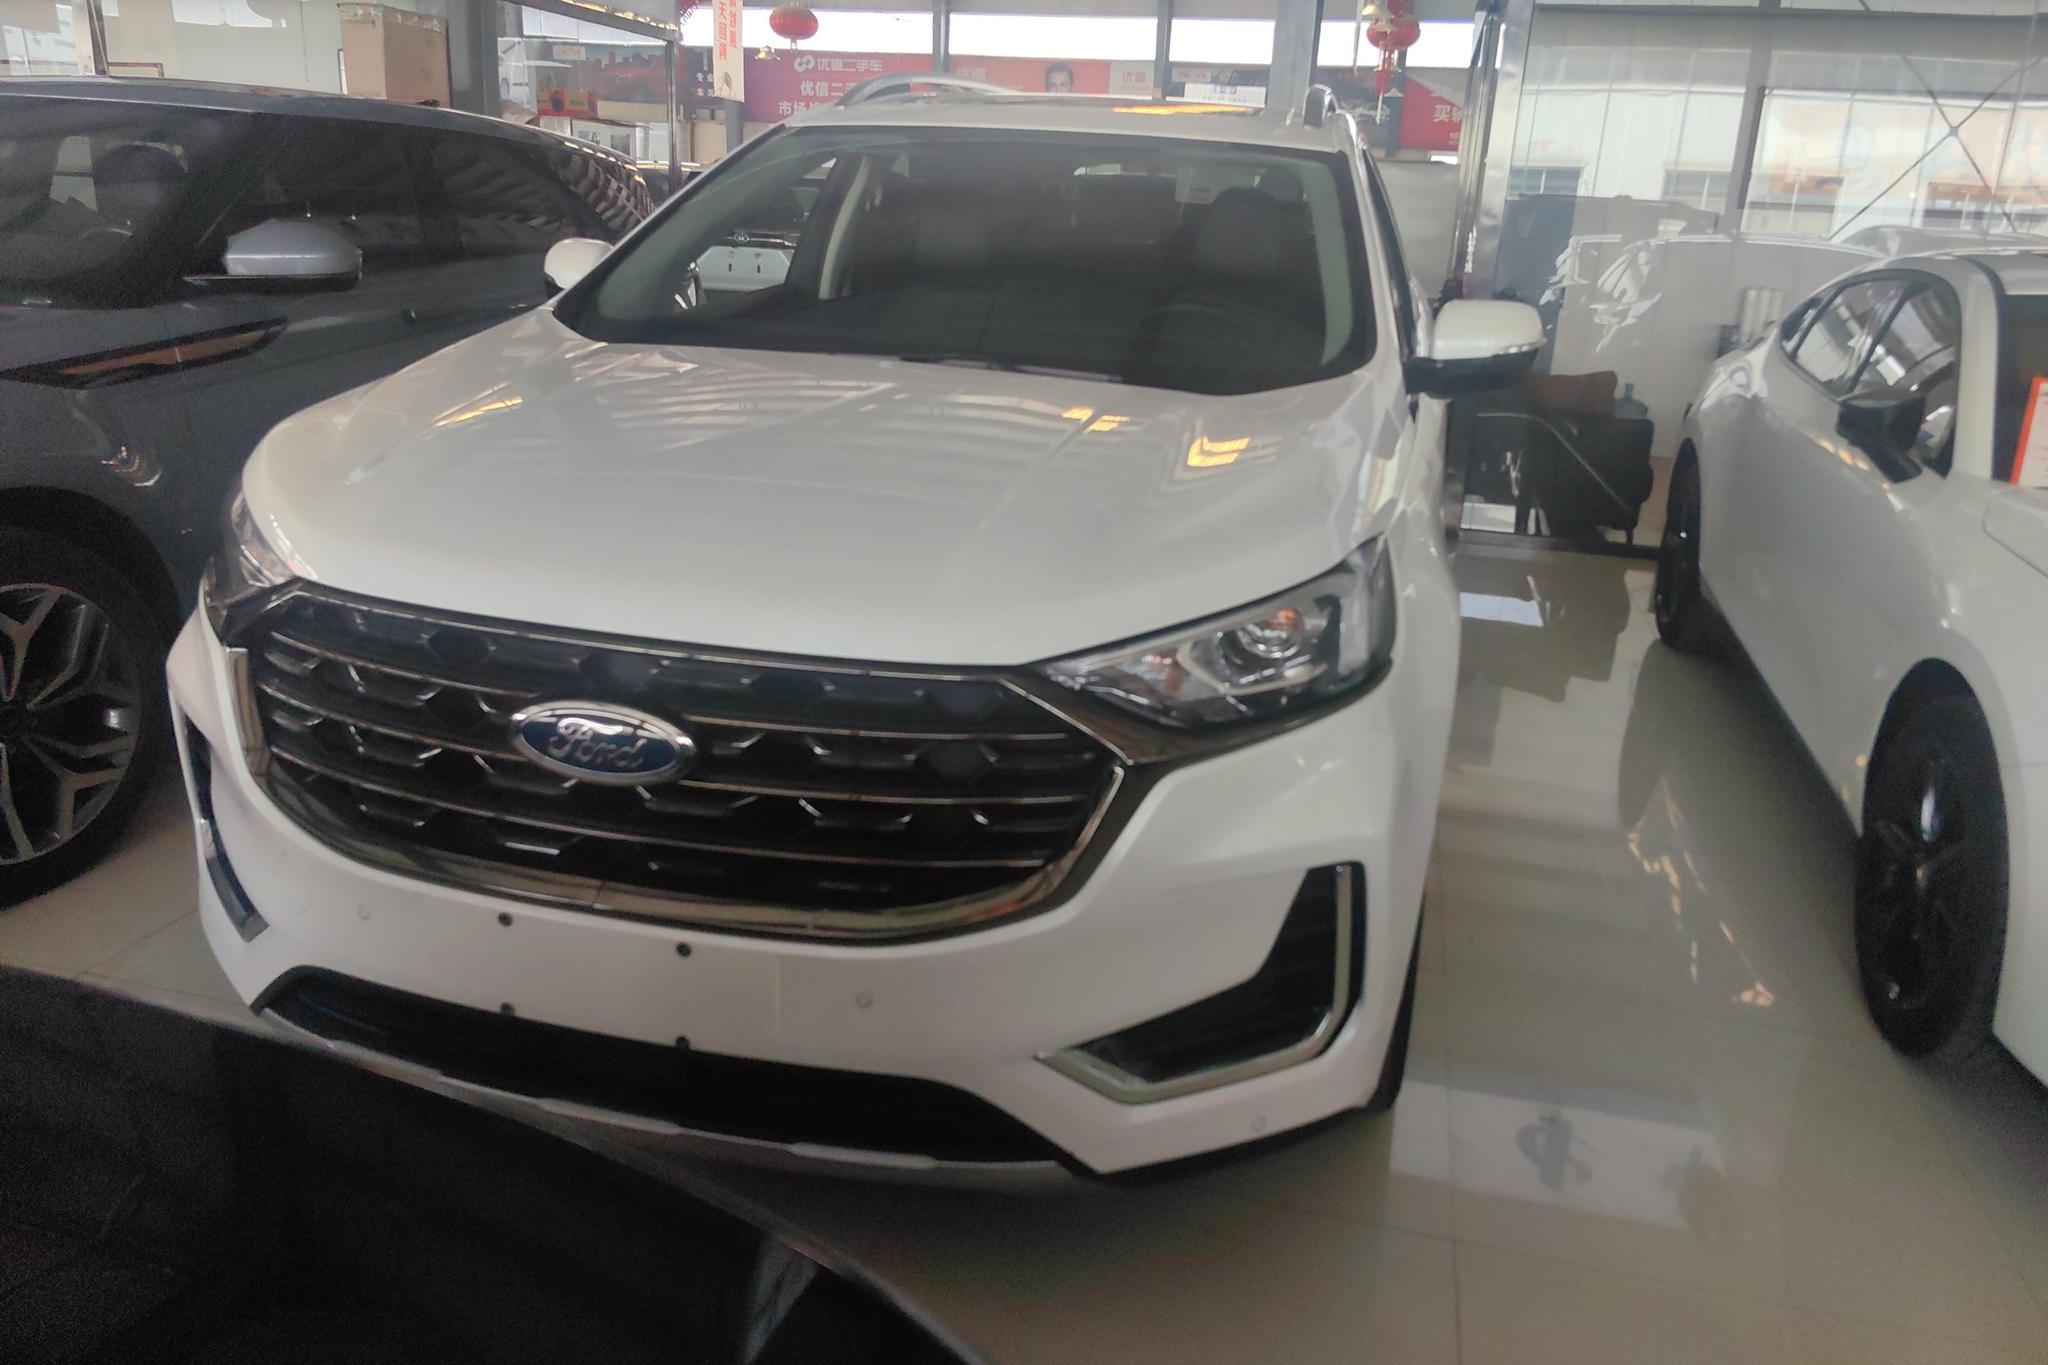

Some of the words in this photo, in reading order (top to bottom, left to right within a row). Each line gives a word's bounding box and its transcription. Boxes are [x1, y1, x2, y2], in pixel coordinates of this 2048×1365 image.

[817, 57, 883, 72] 优信二手车
[546, 716, 649, 769] Ford
